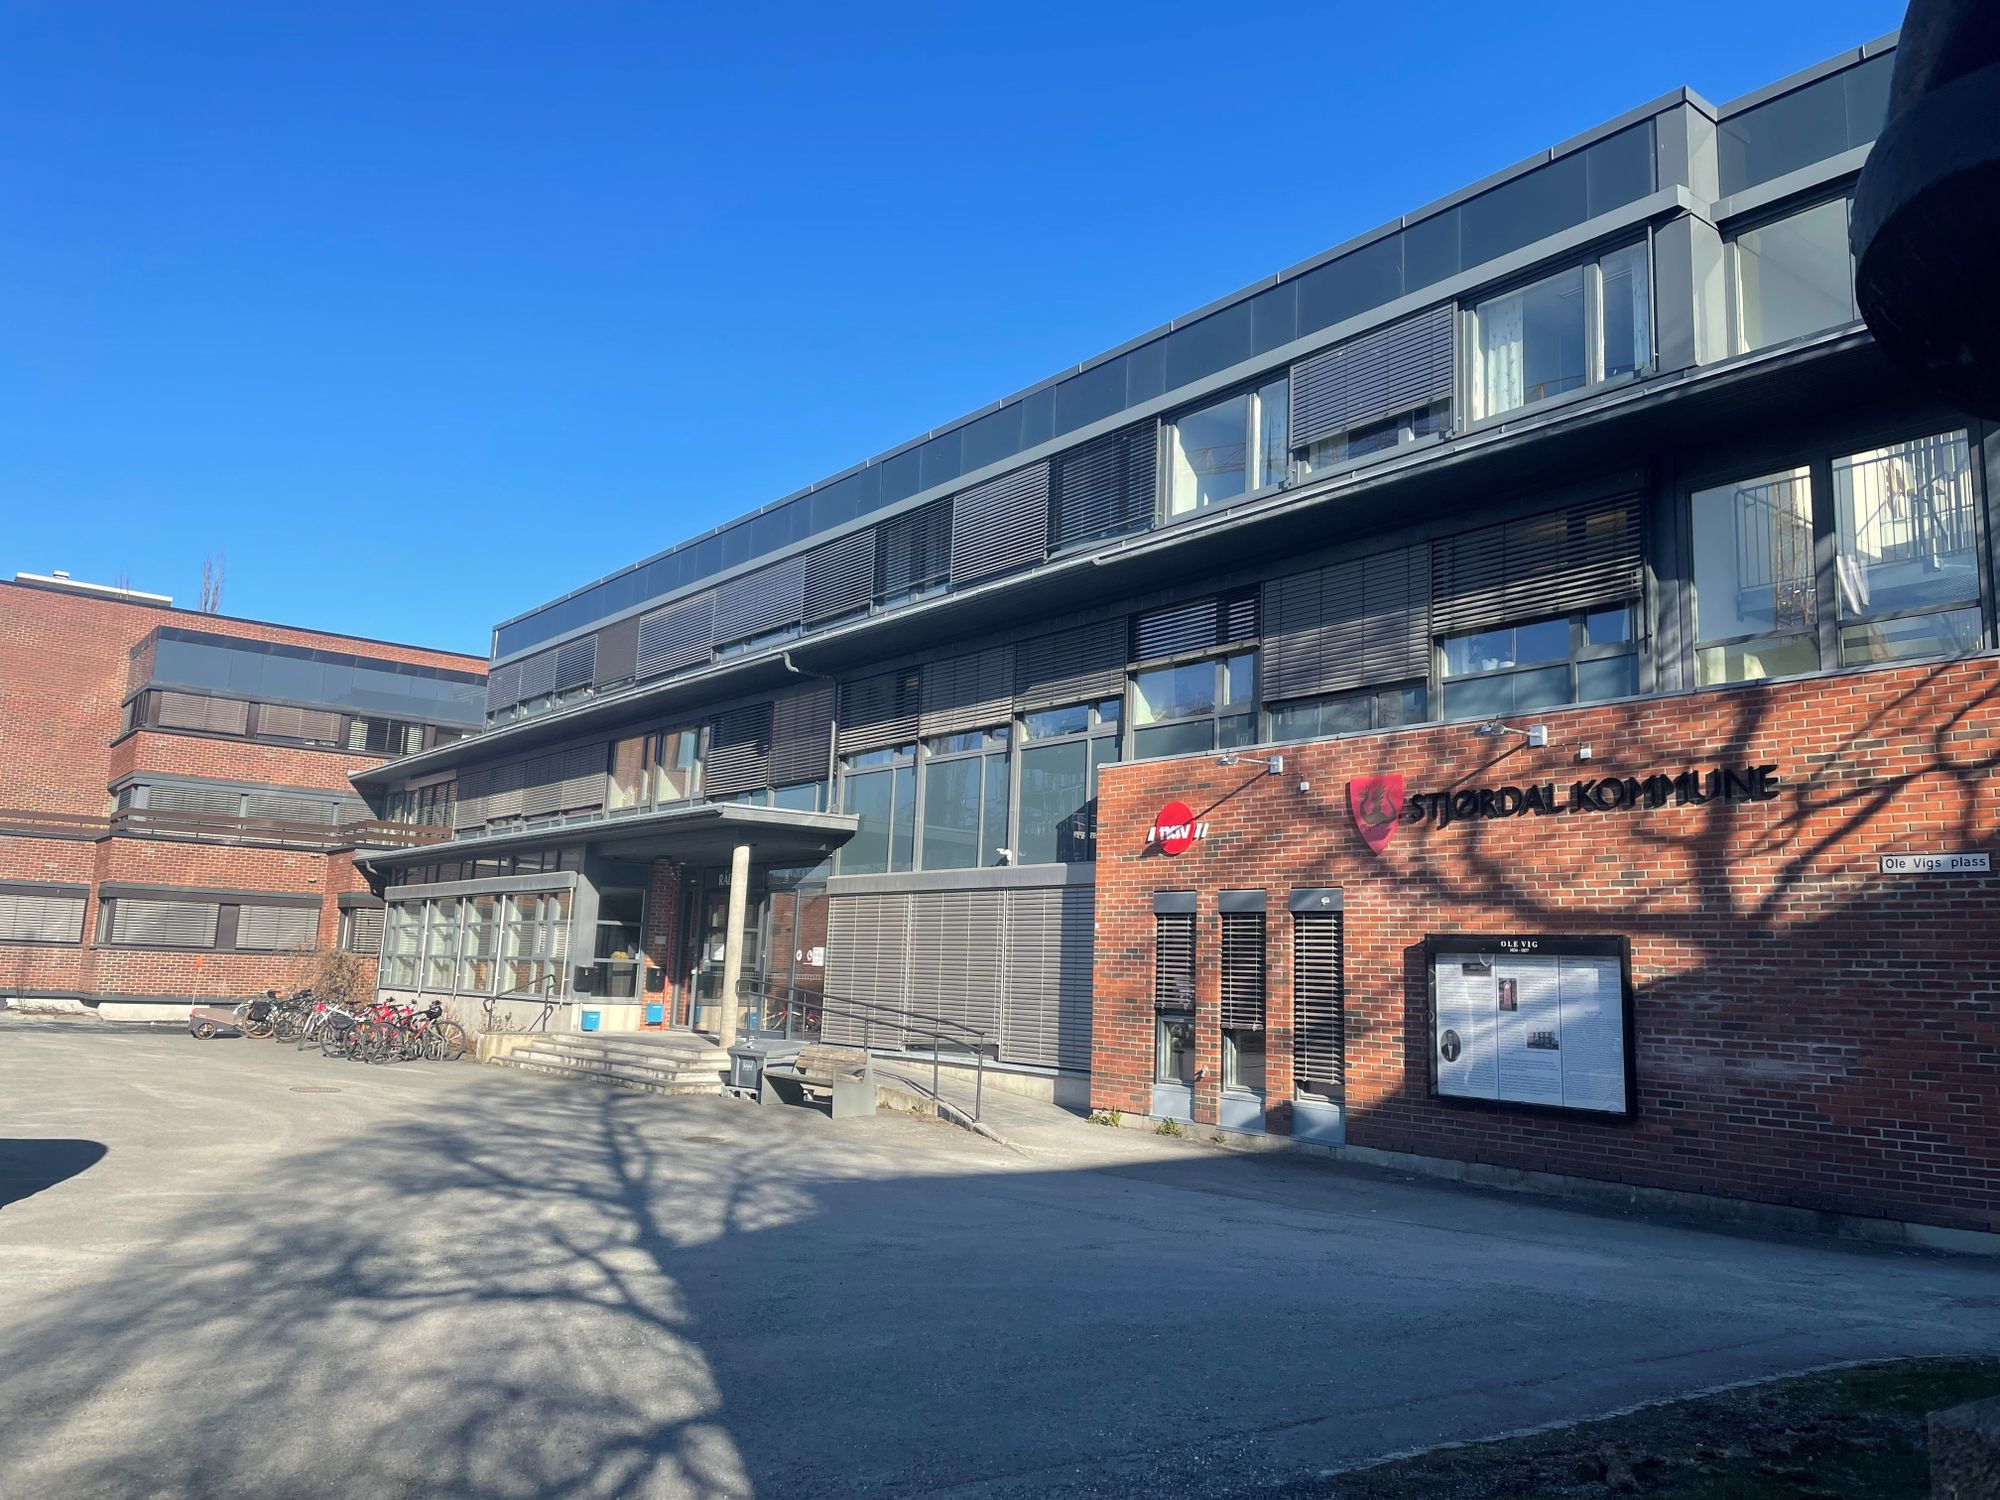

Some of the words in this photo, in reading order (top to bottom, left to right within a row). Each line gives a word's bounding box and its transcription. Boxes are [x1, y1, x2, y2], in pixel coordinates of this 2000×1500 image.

[1410, 784, 1565, 830] STJØRDAL
[1571, 765, 1779, 811] KOMMUNE
[1885, 858, 1906, 869] Ole
[1913, 857, 1942, 871] Vigs
[1951, 856, 1986, 869] plass
[1500, 940, 1519, 948] OLE
[1521, 940, 1538, 948] VIG
